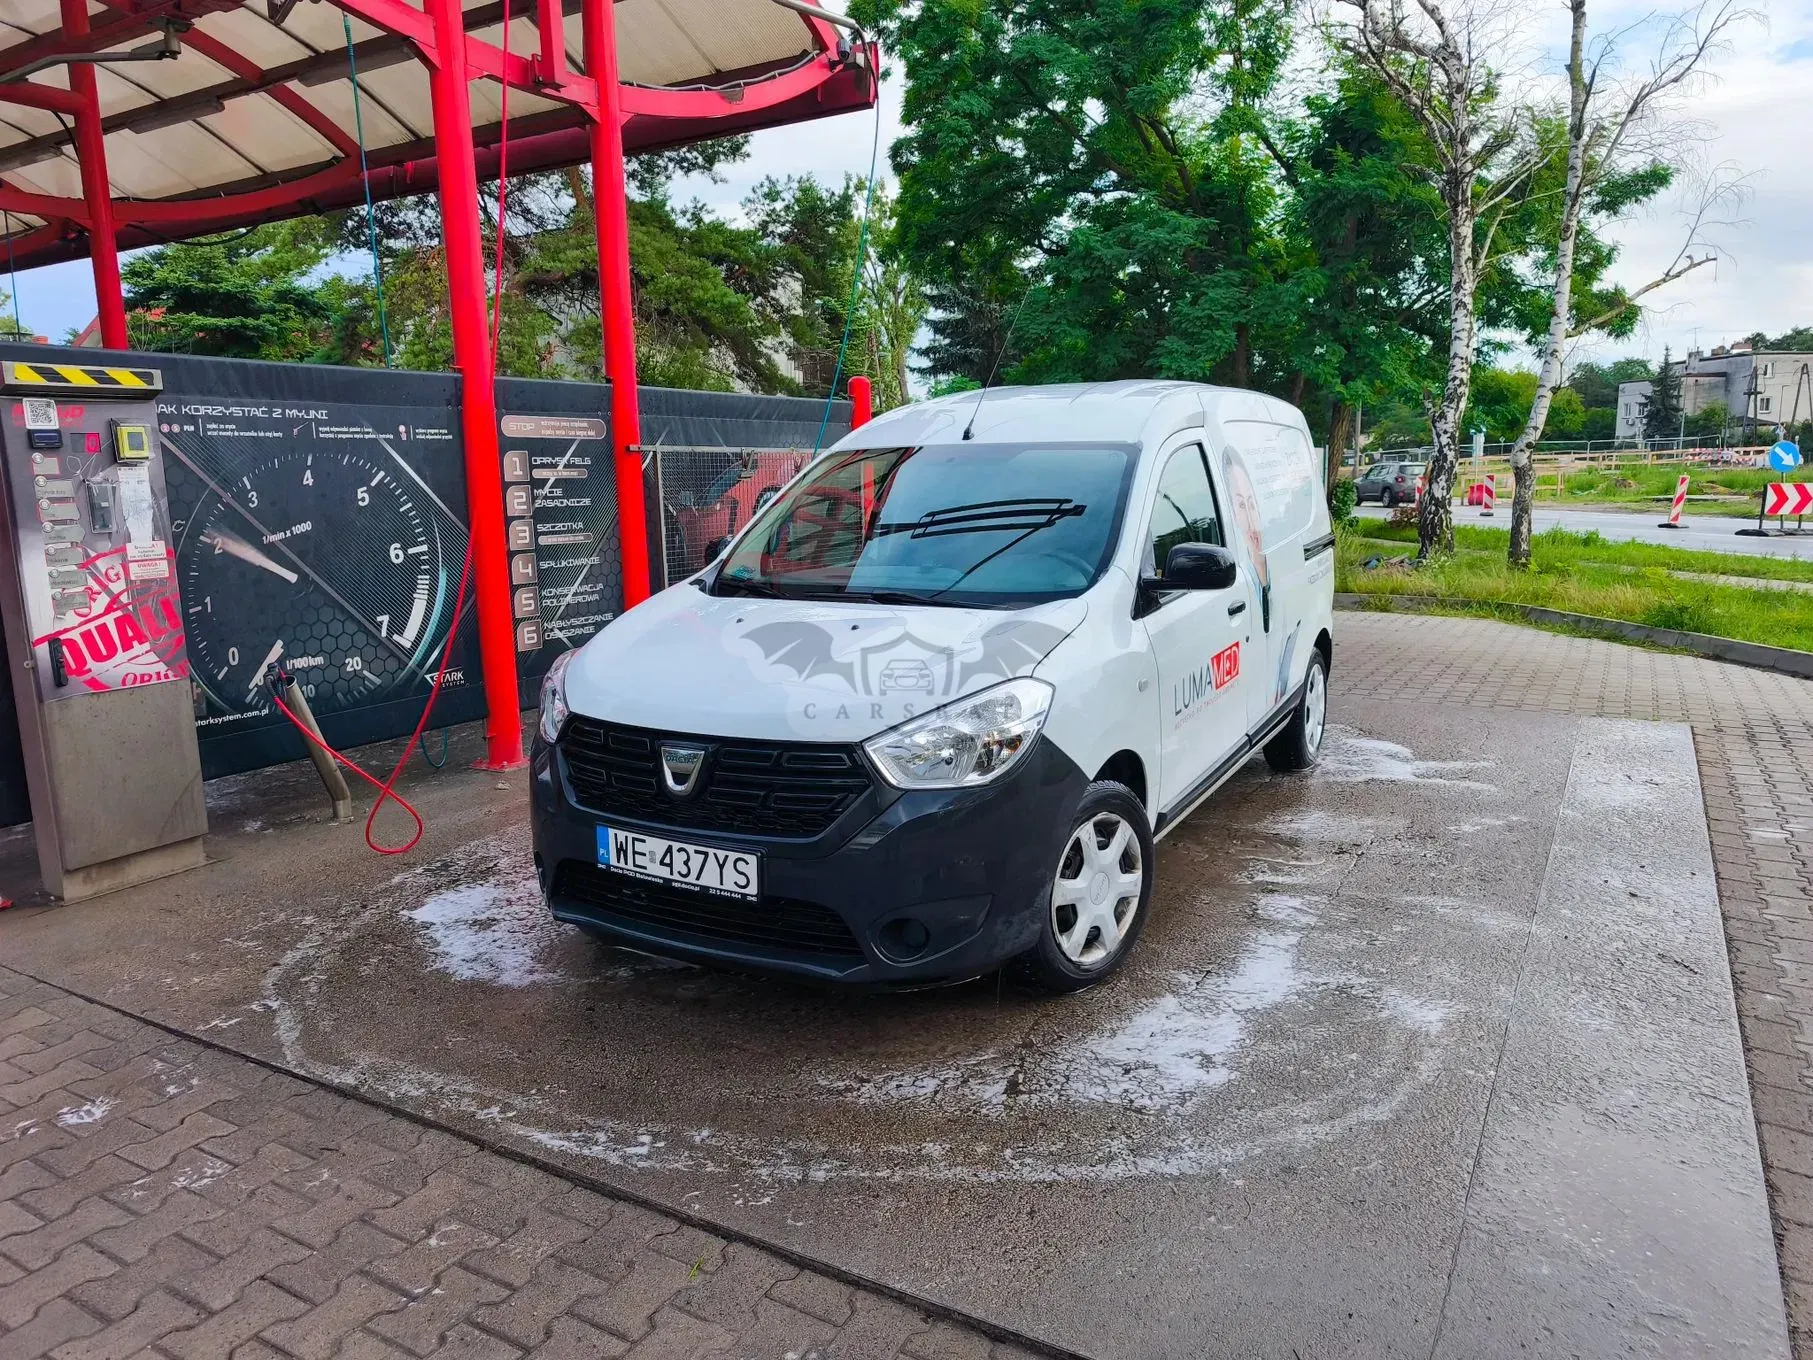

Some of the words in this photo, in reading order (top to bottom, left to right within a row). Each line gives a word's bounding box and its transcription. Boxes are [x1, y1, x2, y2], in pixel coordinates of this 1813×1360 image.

[156, 404, 178, 415] AK
[272, 408, 283, 418] Z
[509, 422, 535, 431] STOP
[512, 457, 523, 475] 1
[303, 470, 314, 486] 4
[248, 491, 259, 507] 3
[357, 487, 370, 506] 5
[513, 492, 527, 510] 2
[262, 529, 286, 544] 1/min
[292, 521, 312, 534] 1000
[516, 526, 529, 544] 3
[537, 522, 584, 532] SZCZOTKA
[213, 538, 223, 555] 2
[389, 543, 404, 564] 6
[519, 561, 532, 577] 4
[204, 596, 213, 613] 1
[522, 593, 535, 611] 5
[376, 614, 390, 638] 7
[524, 626, 538, 645] 6
[228, 646, 239, 665] 0
[345, 656, 362, 672] 20
[600, 848, 608, 858] PL
[614, 833, 647, 870] WE
[659, 844, 751, 890] 437YS
